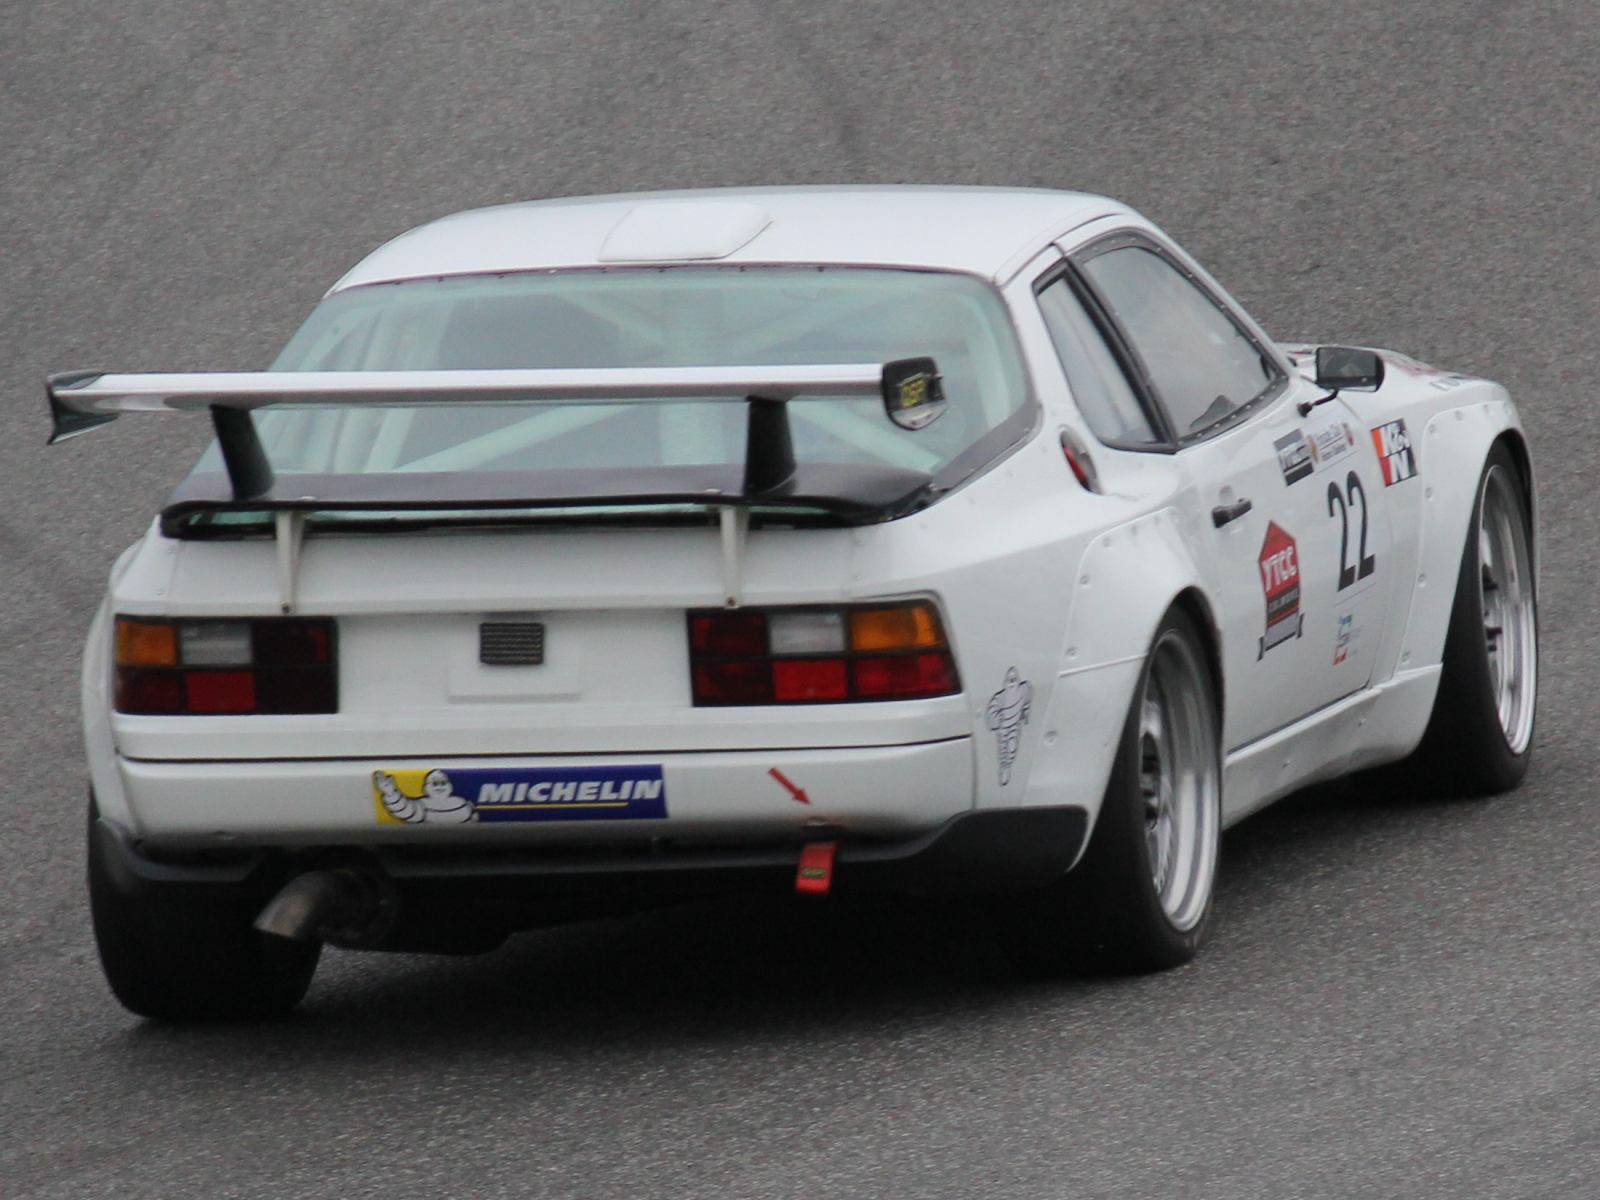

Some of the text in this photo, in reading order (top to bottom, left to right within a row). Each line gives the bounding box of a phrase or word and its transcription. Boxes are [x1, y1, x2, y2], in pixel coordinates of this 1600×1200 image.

[1327, 470, 1375, 592] 22
[1261, 545, 1298, 592] YTCC
[477, 779, 663, 803] MICHELIN
